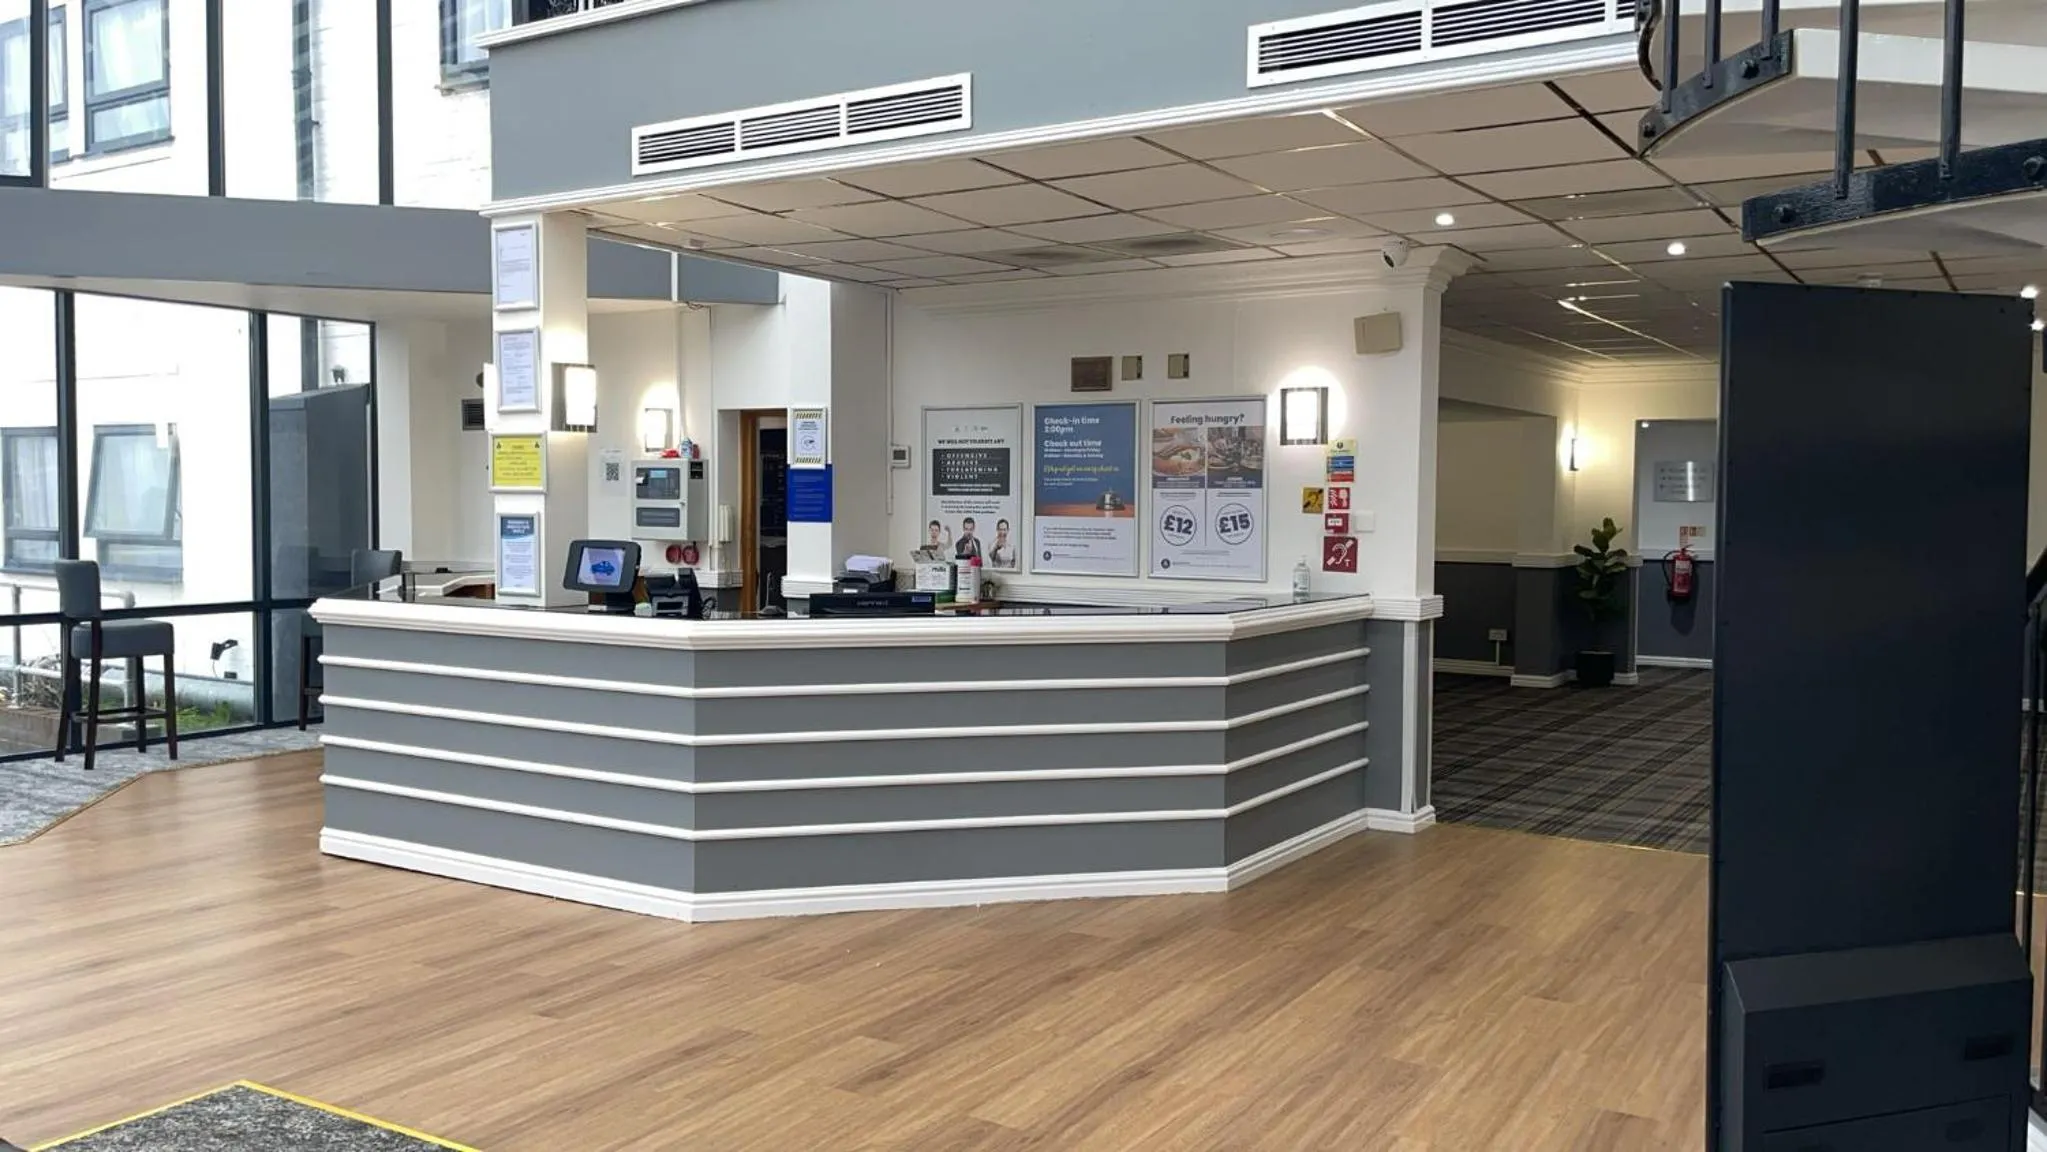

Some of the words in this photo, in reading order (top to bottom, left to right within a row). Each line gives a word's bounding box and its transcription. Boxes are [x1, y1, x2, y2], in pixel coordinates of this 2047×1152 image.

[1044, 416, 1080, 425] Check-in
[1170, 415, 1203, 425] Feeling
[1204, 413, 1245, 424] hungry?
[1164, 514, 1193, 535] £12
[1219, 513, 1250, 534] £15
